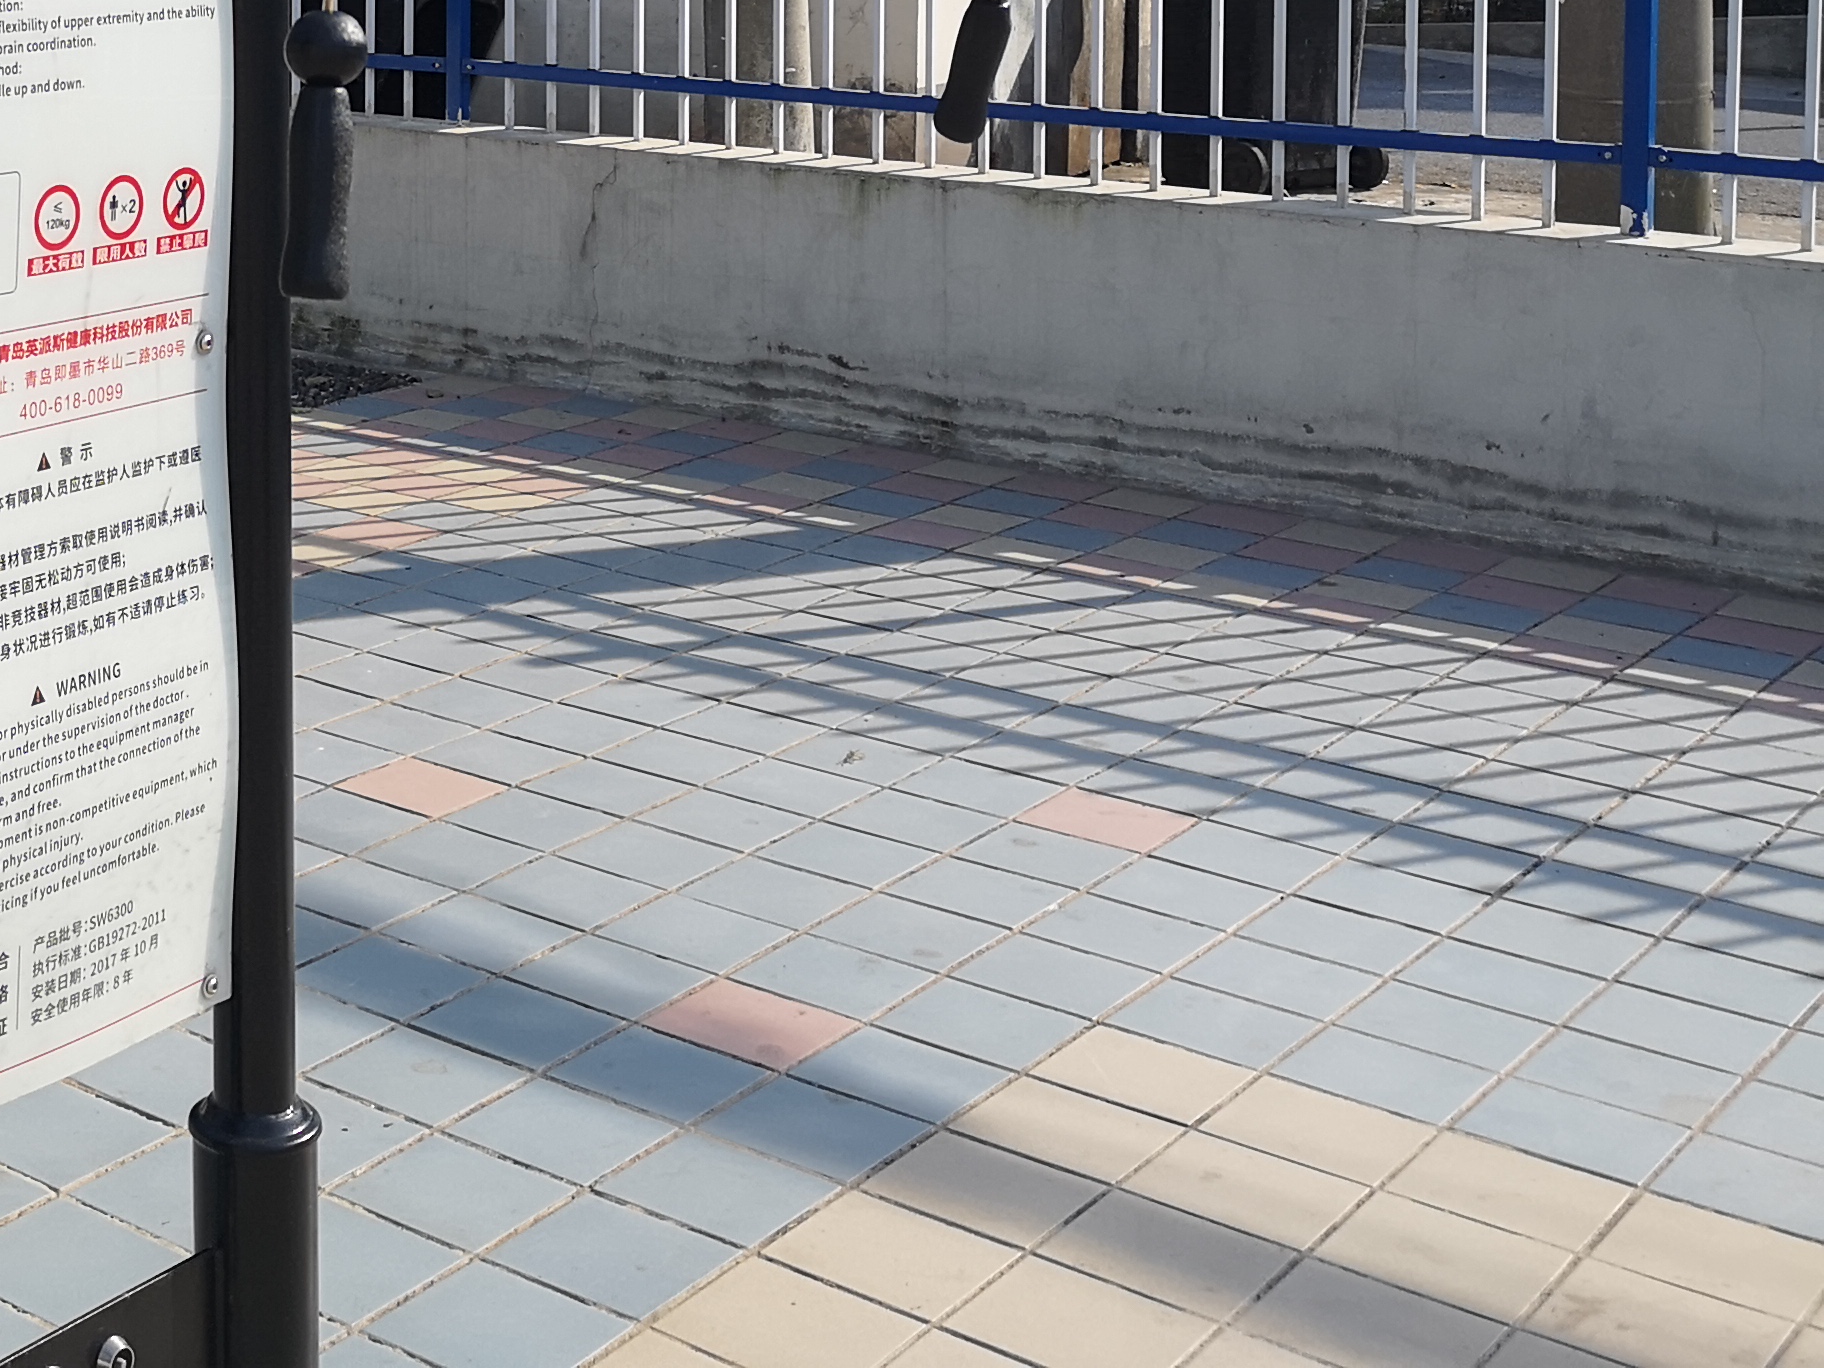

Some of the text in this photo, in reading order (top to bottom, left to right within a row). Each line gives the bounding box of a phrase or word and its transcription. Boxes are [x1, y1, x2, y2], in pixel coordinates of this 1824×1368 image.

[51, 16, 62, 30] of
[64, 16, 94, 30] upper
[96, 10, 144, 25] extremity
[147, 8, 165, 22] and
[167, 6, 183, 20] the
[185, 5, 216, 20] ability
[26, 35, 96, 52] coordination.
[14, 84, 28, 98] up
[30, 79, 50, 94] and
[52, 78, 85, 92] down.
[46, 218, 71, 231] 120kg
[19, 383, 124, 420] 400-618-0099
[56, 662, 122, 698] WARNING
[10, 709, 64, 740] physically
[66, 692, 110, 718] disabled
[112, 680, 151, 706] persons
[152, 666, 185, 688] should
[186, 664, 198, 678] be
[200, 660, 209, 672] in
[8, 738, 41, 760] under
[42, 733, 60, 748] the
[62, 712, 122, 740] supervision
[124, 704, 134, 720] of
[134, 701, 151, 716] the
[65, 750, 76, 762] to
[78, 742, 94, 757] the
[96, 722, 151, 750] equipment
[152, 706, 195, 730] manager
[10, 784, 31, 803] and
[32, 771, 74, 794] confirm
[76, 762, 97, 779] that
[98, 756, 116, 770] the
[118, 736, 172, 764] connection
[174, 728, 184, 744] of
[184, 724, 201, 740] the
[14, 804, 35, 823] and
[36, 798, 62, 814] free.
[34, 824, 44, 837] is
[45, 792, 130, 832] non-competitive
[132, 770, 188, 800] equipment,
[190, 758, 218, 778] which
[2, 842, 48, 871] physical
[49, 832, 84, 852] injury.
[32, 852, 85, 880] according
[86, 846, 97, 859] to
[98, 836, 122, 858] your
[123, 818, 174, 844] condition.
[175, 804, 206, 824] Please
[30, 886, 38, 902] if
[39, 882, 60, 900] you
[61, 870, 82, 890] feel
[82, 842, 160, 882] uncomfortable.
